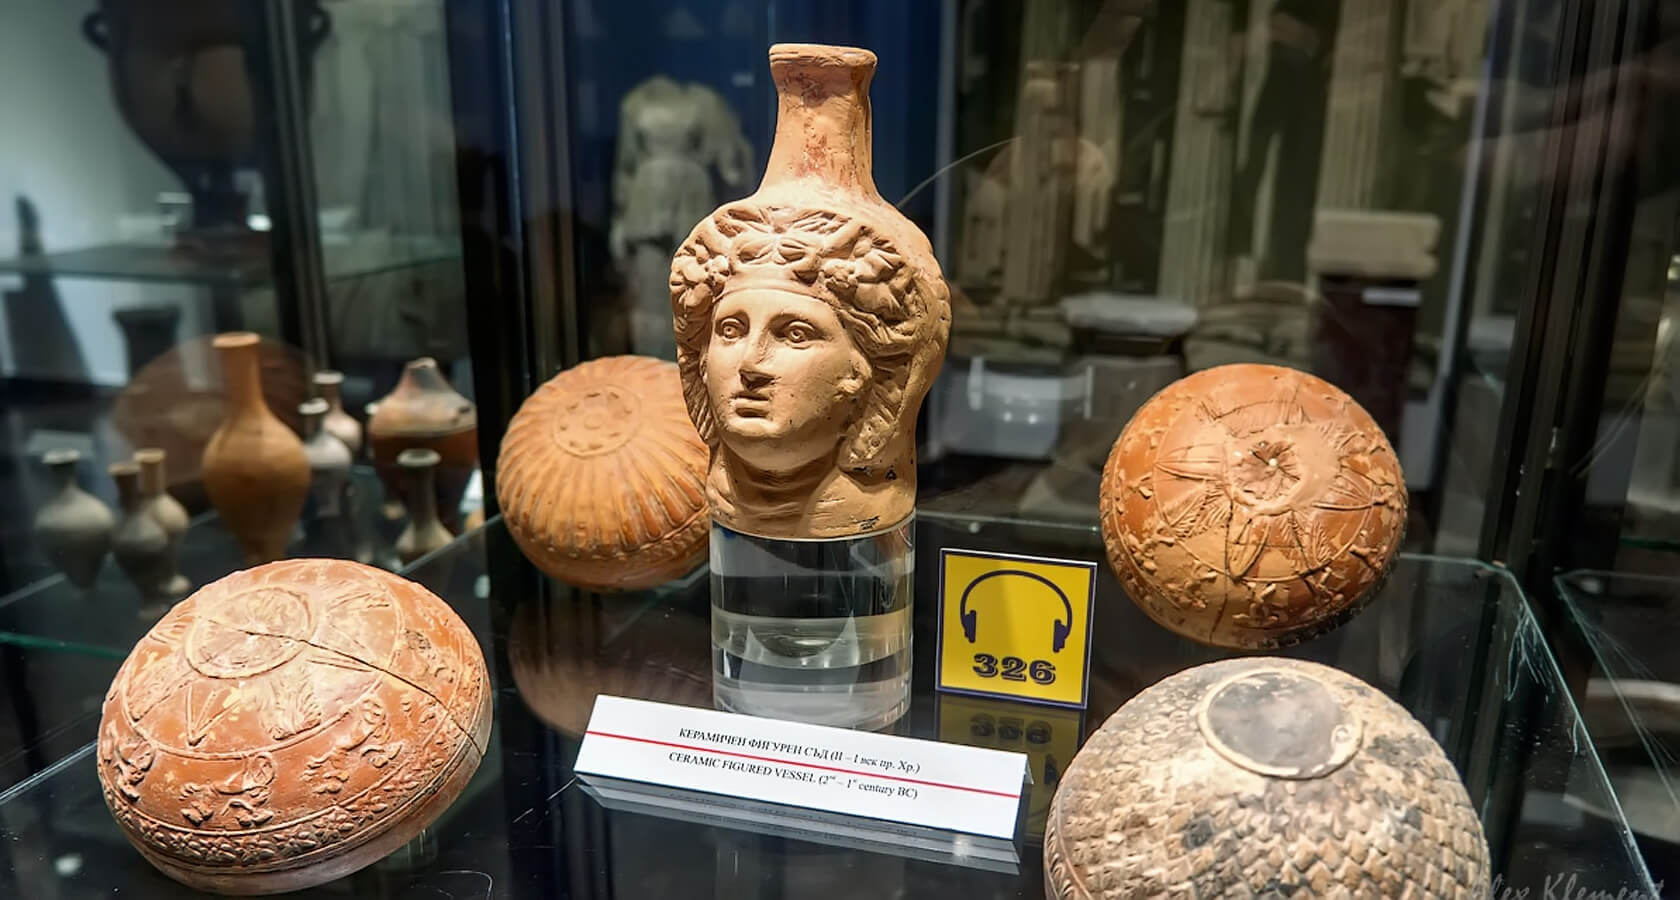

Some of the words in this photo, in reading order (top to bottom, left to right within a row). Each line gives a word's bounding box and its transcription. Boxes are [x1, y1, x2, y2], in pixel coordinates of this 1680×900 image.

[972, 653, 1056, 685] 326
[679, 728, 746, 746] КЕРАМИЧЕН
[748, 738, 802, 755] ФИГУРЕН
[804, 746, 829, 760] СЪД
[669, 752, 721, 768] CERAMIC
[722, 759, 772, 776] FIGURED
[775, 768, 816, 783] VESSEL
[858, 782, 895, 797] century
[897, 786, 918, 800] BC)
